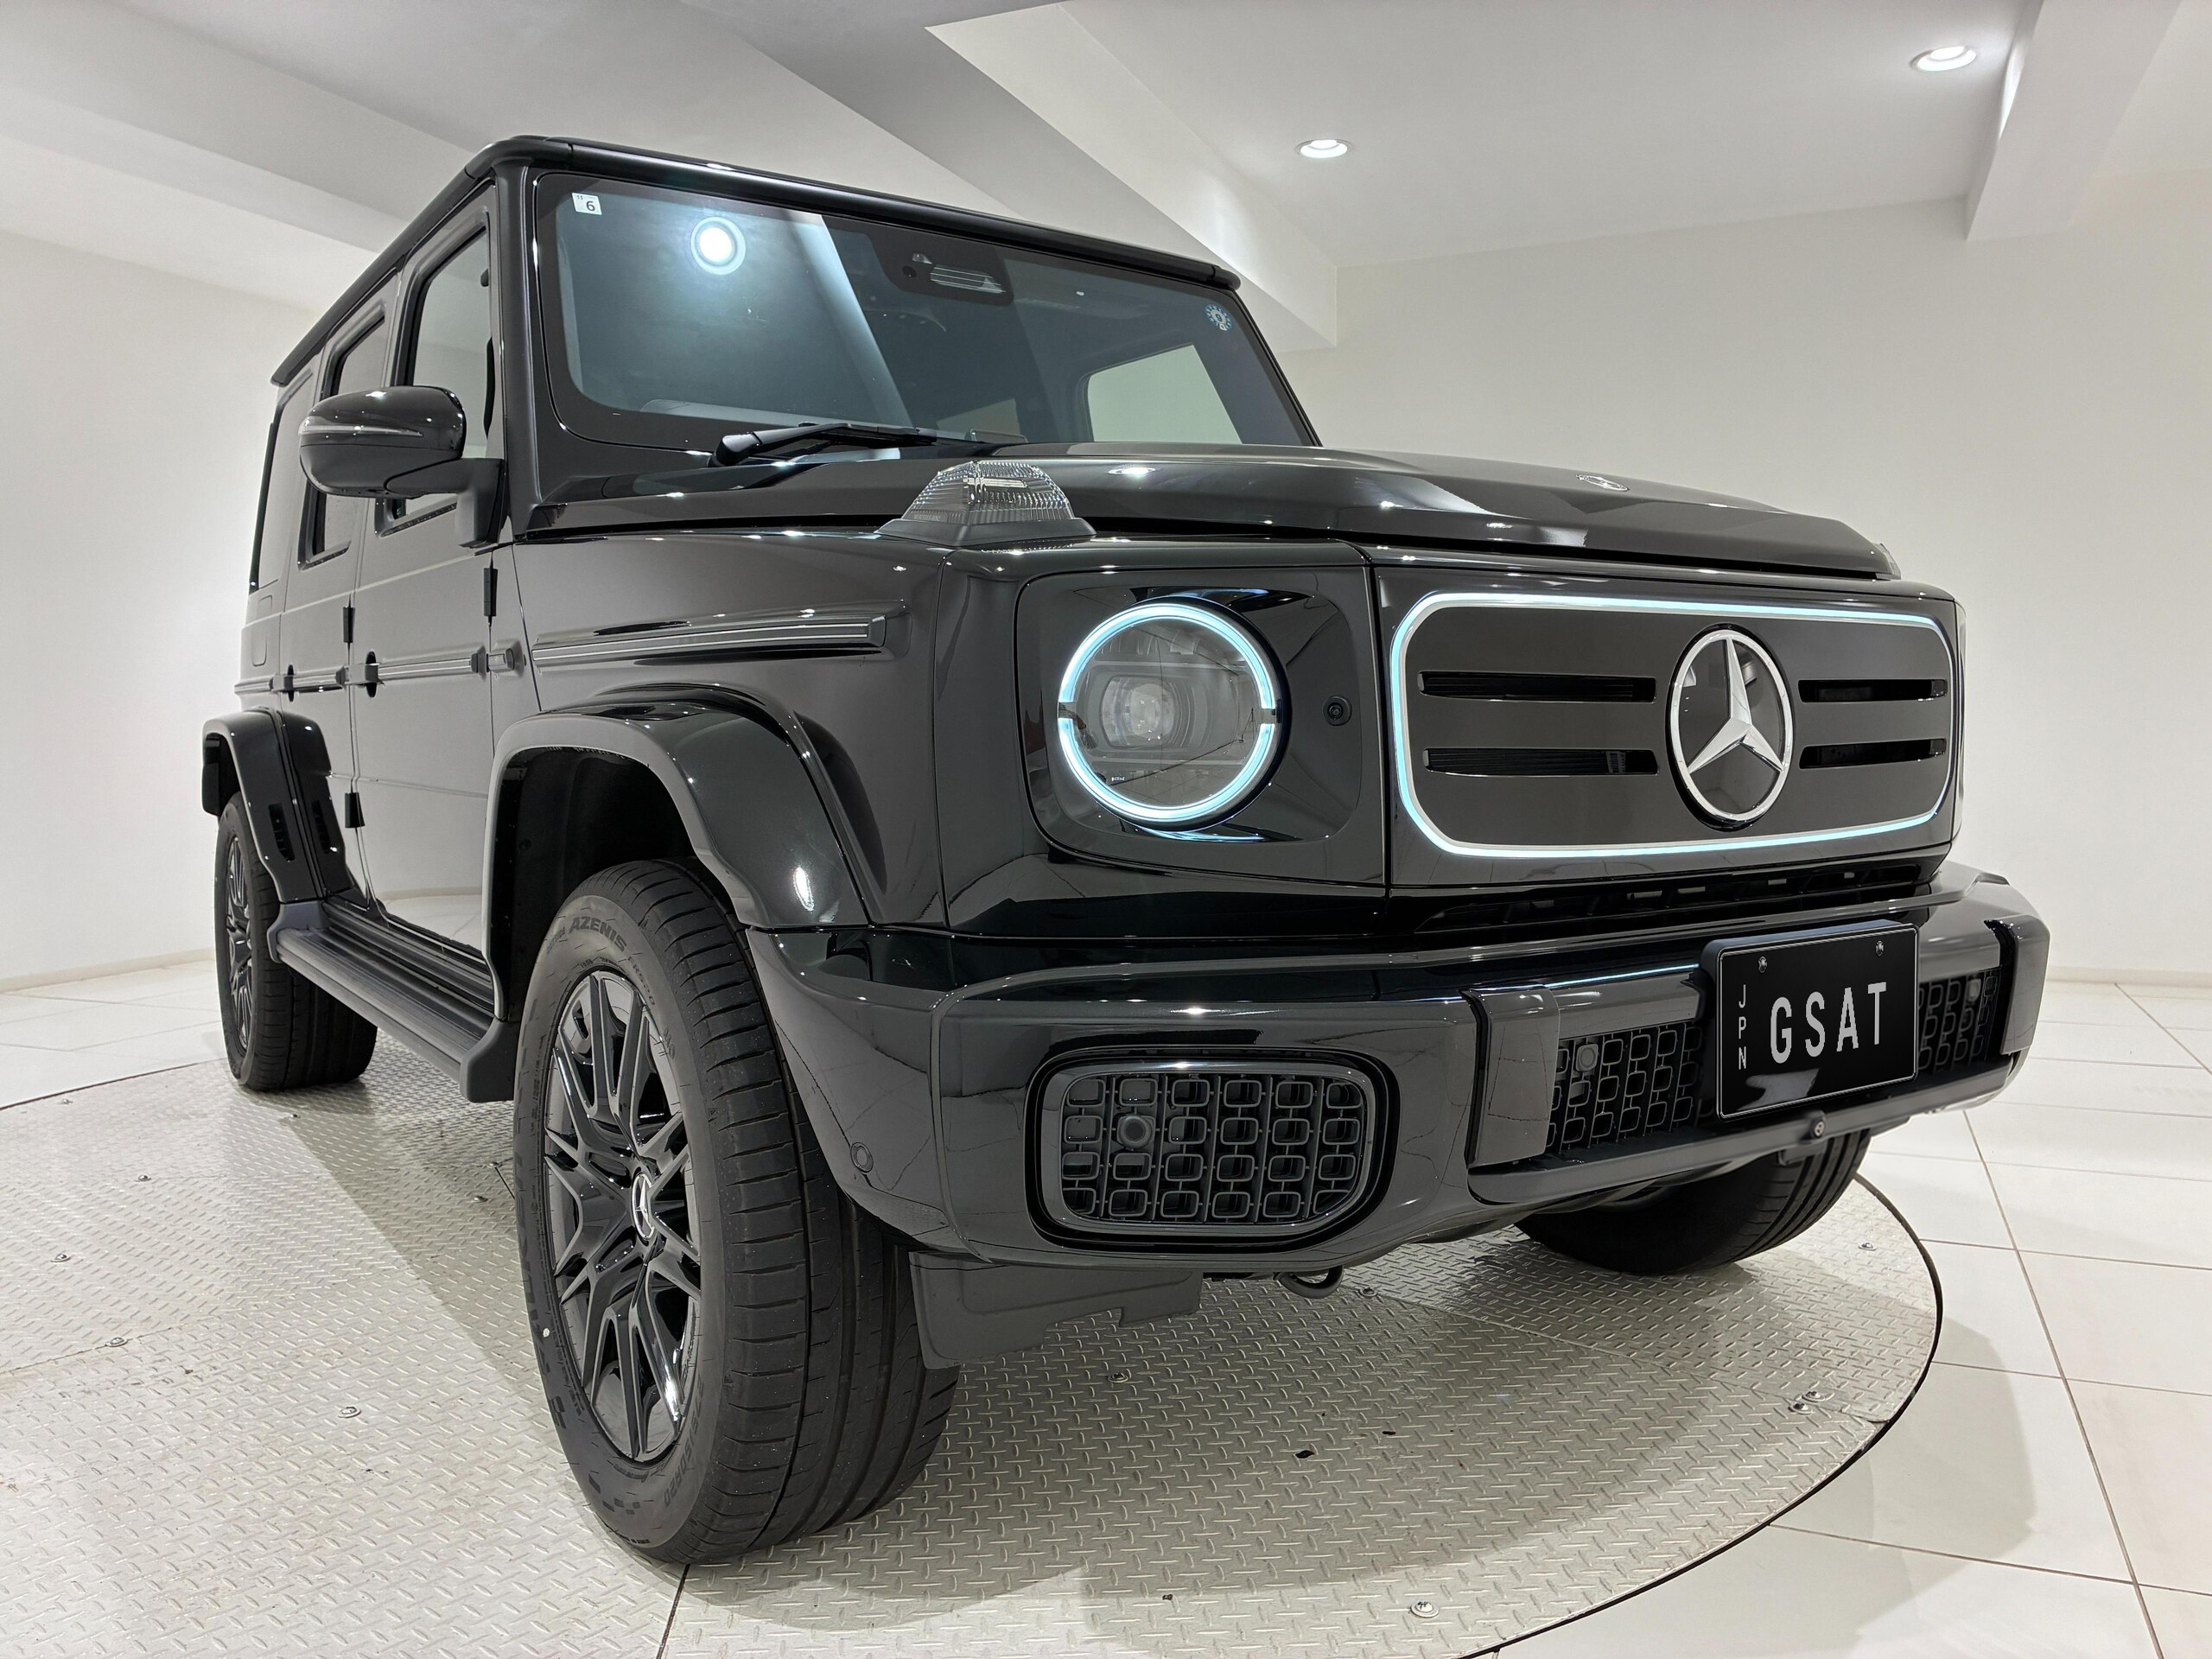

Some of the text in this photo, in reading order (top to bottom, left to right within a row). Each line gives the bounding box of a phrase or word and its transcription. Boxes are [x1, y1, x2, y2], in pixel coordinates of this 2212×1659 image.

[586, 200, 595, 212] 6
[569, 916, 627, 951] AZENIS
[1770, 982, 1886, 1064] GSAT
